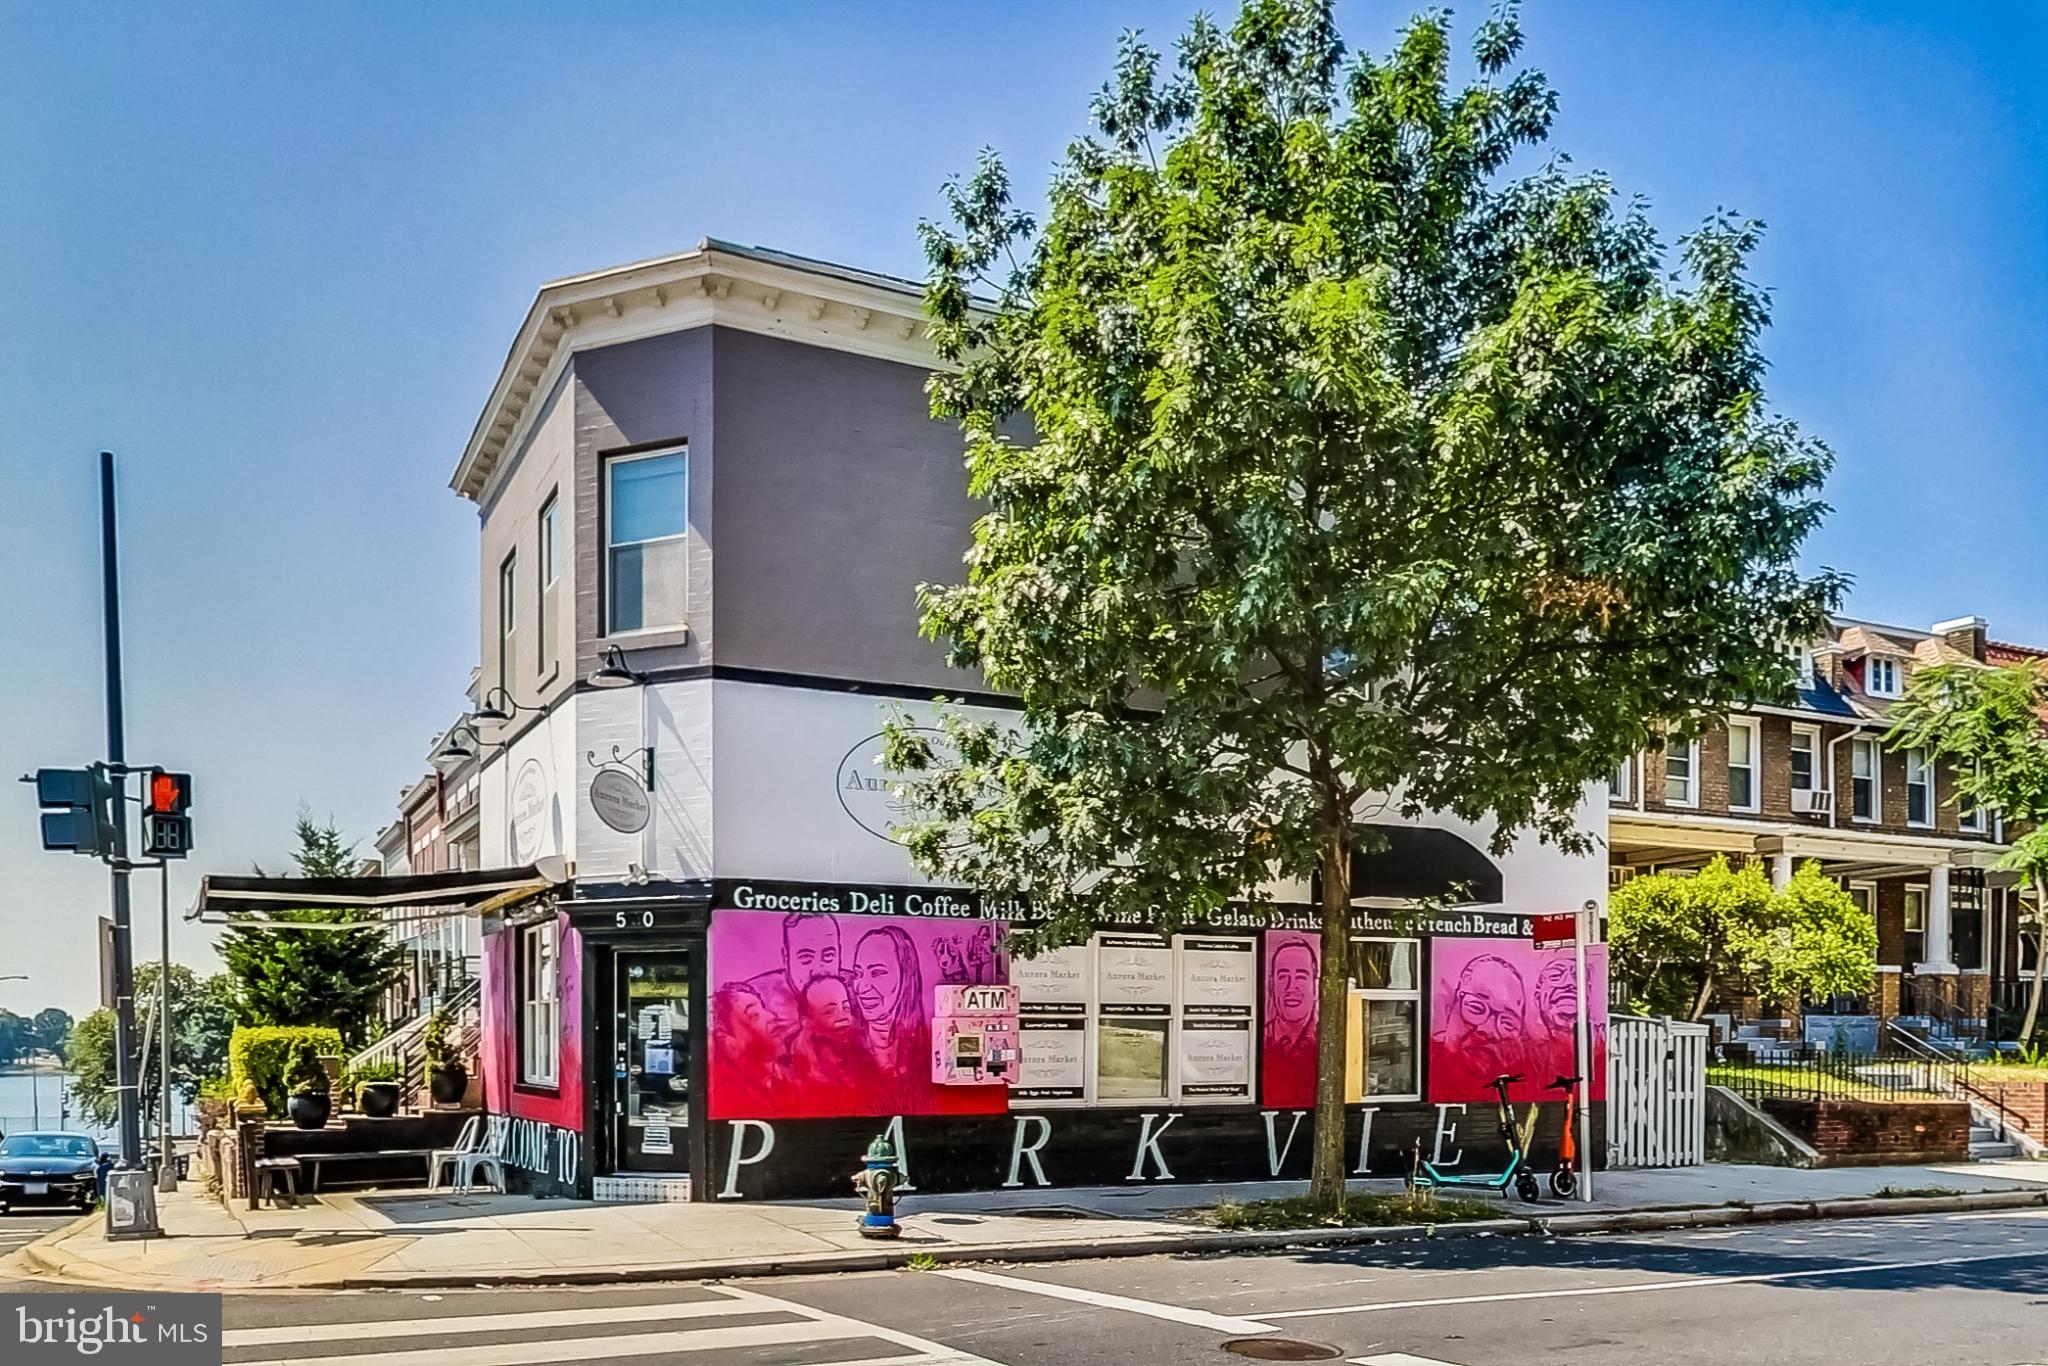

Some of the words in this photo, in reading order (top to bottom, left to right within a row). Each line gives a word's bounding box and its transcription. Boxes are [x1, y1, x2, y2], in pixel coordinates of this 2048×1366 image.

[733, 886, 840, 912] Groceries
[850, 892, 895, 914] Deli
[905, 895, 970, 918] Coffee
[979, 898, 1026, 921] Milk
[1474, 917, 1518, 936] Bread
[967, 991, 1005, 1008] ATM
[556, 1128, 578, 1185] TO
